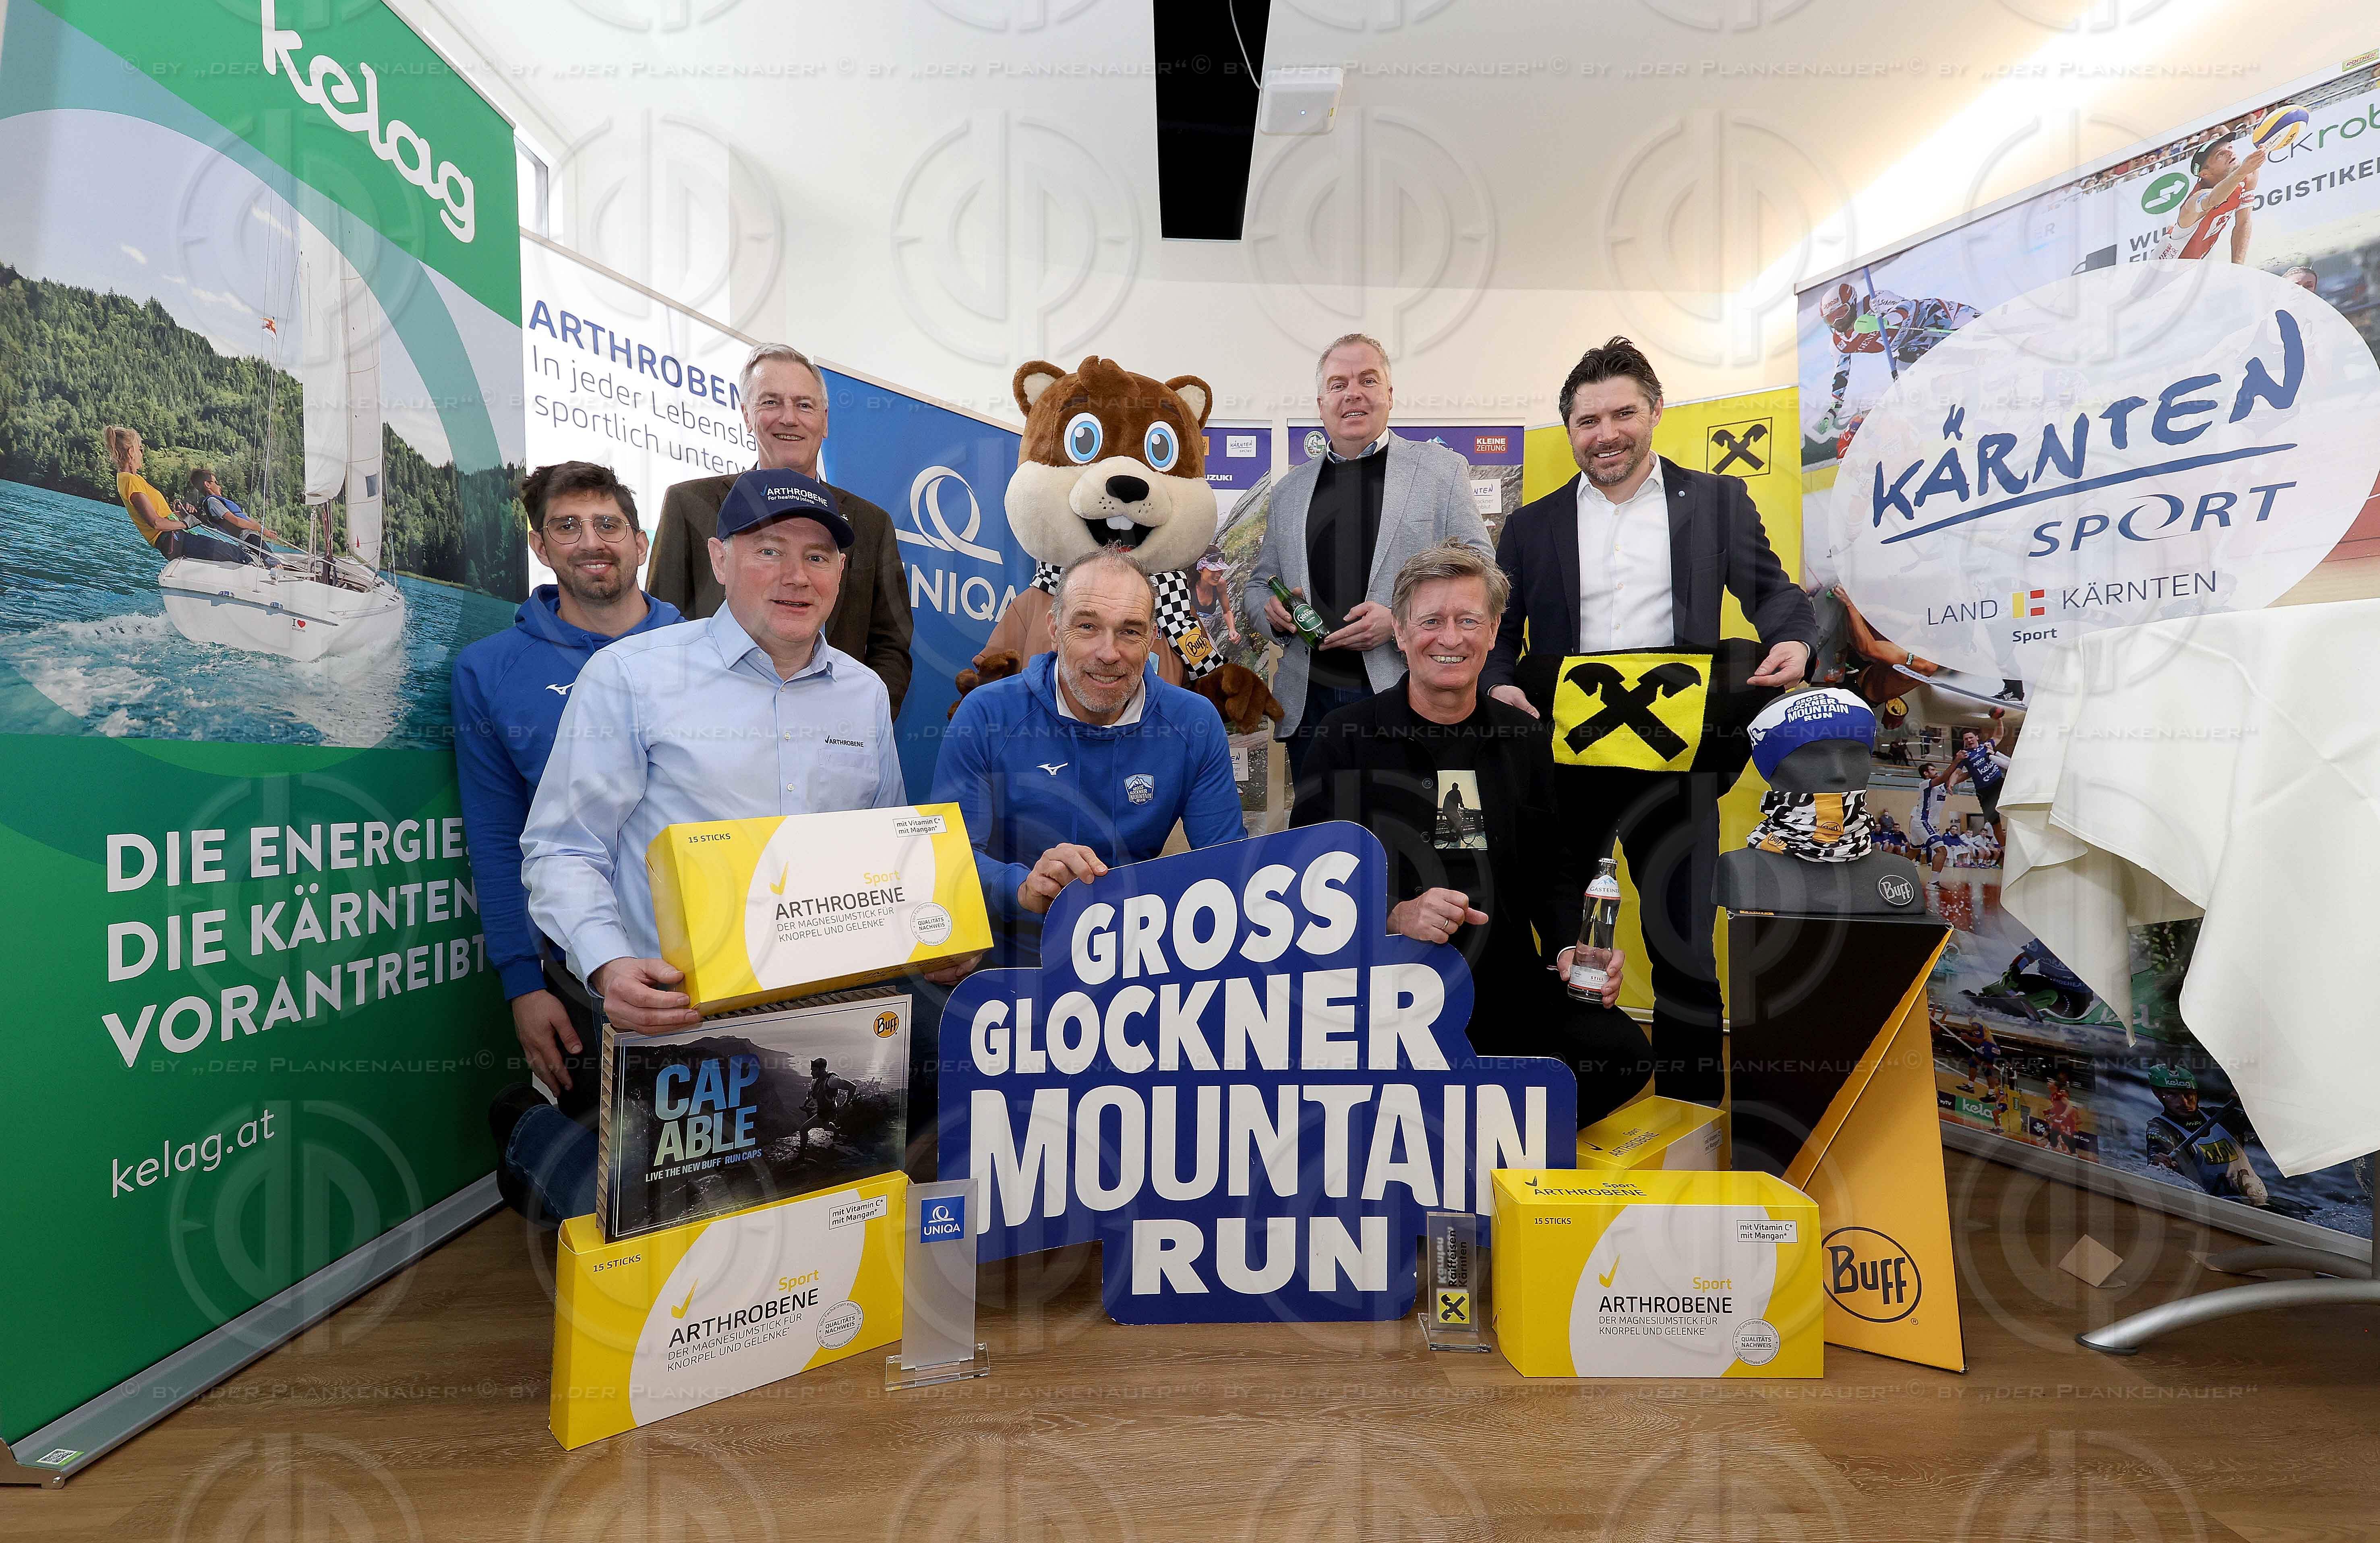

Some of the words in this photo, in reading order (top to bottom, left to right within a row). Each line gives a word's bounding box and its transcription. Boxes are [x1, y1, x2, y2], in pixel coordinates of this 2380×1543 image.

[261, 0, 474, 243] kelag
[2252, 157, 2380, 211] OGISTIKE
[529, 300, 741, 410] ARTHROBEN
[533, 345, 560, 380] In
[570, 360, 641, 408] jeder
[652, 391, 756, 451] Lebensla
[1873, 309, 2305, 528] KÄRNTEN
[535, 395, 659, 453] sportlich
[669, 441, 746, 475] unterw
[767, 488, 828, 507] ARTHROBENE
[1473, 483, 1493, 494] NTEN
[800, 496, 815, 504] joints
[2028, 481, 2297, 558] SPORT
[902, 563, 1017, 623] NIQA
[1927, 600, 1998, 625] LAND
[2061, 570, 2217, 610] KÄRNTEN
[1187, 635, 1207, 656] Buff
[2013, 627, 2057, 643] Sport
[1787, 698, 1837, 714] GLOCKNER
[1796, 694, 1825, 705] GROSS
[1788, 704, 1849, 723] MOUNTAIN
[1804, 712, 1833, 722] RUN
[830, 739, 863, 747] ARTHROBENE
[1130, 793, 1151, 801] MOUNTAIN
[700, 833, 731, 842] STICKS
[107, 829, 225, 893] DIE
[863, 870, 900, 886] Sport
[1881, 881, 1910, 900] Buff
[776, 887, 905, 920] ARTHROBENE
[777, 922, 796, 932] DER
[798, 909, 876, 928] MAGNESIUMSTICK
[878, 906, 894, 916] FÜR
[919, 922, 945, 931] NACHWEIS
[1071, 851, 1361, 985] GROSS
[107, 909, 226, 982] DIE
[250, 877, 478, 956] KÄRNTEN
[778, 930, 822, 942] KNORPEL
[824, 925, 844, 935] UND
[102, 937, 485, 1068] VORANTREIBT
[876, 1016, 899, 1034] Buff
[970, 963, 1451, 1076] GLOCKNER
[655, 1053, 760, 1121] CAP
[2165, 1078, 2191, 1088] kelag
[1962, 1098, 1994, 1119] kela
[654, 1105, 757, 1167] ABLE
[1622, 1127, 1643, 1137] Sport
[112, 1109, 275, 1198] kelag.at
[1608, 1131, 1660, 1157] ARTHROBENE
[646, 1170, 664, 1182] LIVE
[665, 1167, 681, 1178] THE
[682, 1162, 702, 1174] NEW
[702, 1157, 721, 1169] BUFF
[725, 1153, 741, 1164] RUN
[742, 1148, 762, 1160] CAPS
[971, 1083, 1548, 1235] MOUNTAIN
[832, 1209, 844, 1217] mit
[846, 1202, 873, 1213] Vitamin
[832, 1217, 844, 1225] mit
[923, 1224, 961, 1236] UNIQA
[593, 1263, 604, 1272] 15
[606, 1254, 642, 1271] STICKS
[1132, 1215, 1388, 1294] RUN
[778, 1269, 819, 1292] Sport
[1693, 1277, 1732, 1293] Sport
[1827, 1244, 1907, 1305] Buff
[1599, 1296, 1733, 1313] ARTHROBENE
[668, 1288, 819, 1348] ARTHROBENE
[825, 1315, 855, 1329] QUALITÄTS
[825, 1321, 855, 1334] NACHWEIS
[1599, 1316, 1616, 1324] DER
[1619, 1316, 1698, 1325] MAGNESIUMSTICK
[1700, 1315, 1718, 1325] FÜR
[668, 1347, 689, 1361] DER
[692, 1320, 781, 1354] MAGNESIUMSTICK
[784, 1313, 802, 1325] FÜR
[1599, 1327, 1641, 1335] KNORPEL
[1643, 1327, 1662, 1335] UND
[667, 1352, 716, 1372] KNORPEL
[719, 1342, 741, 1356] UND
